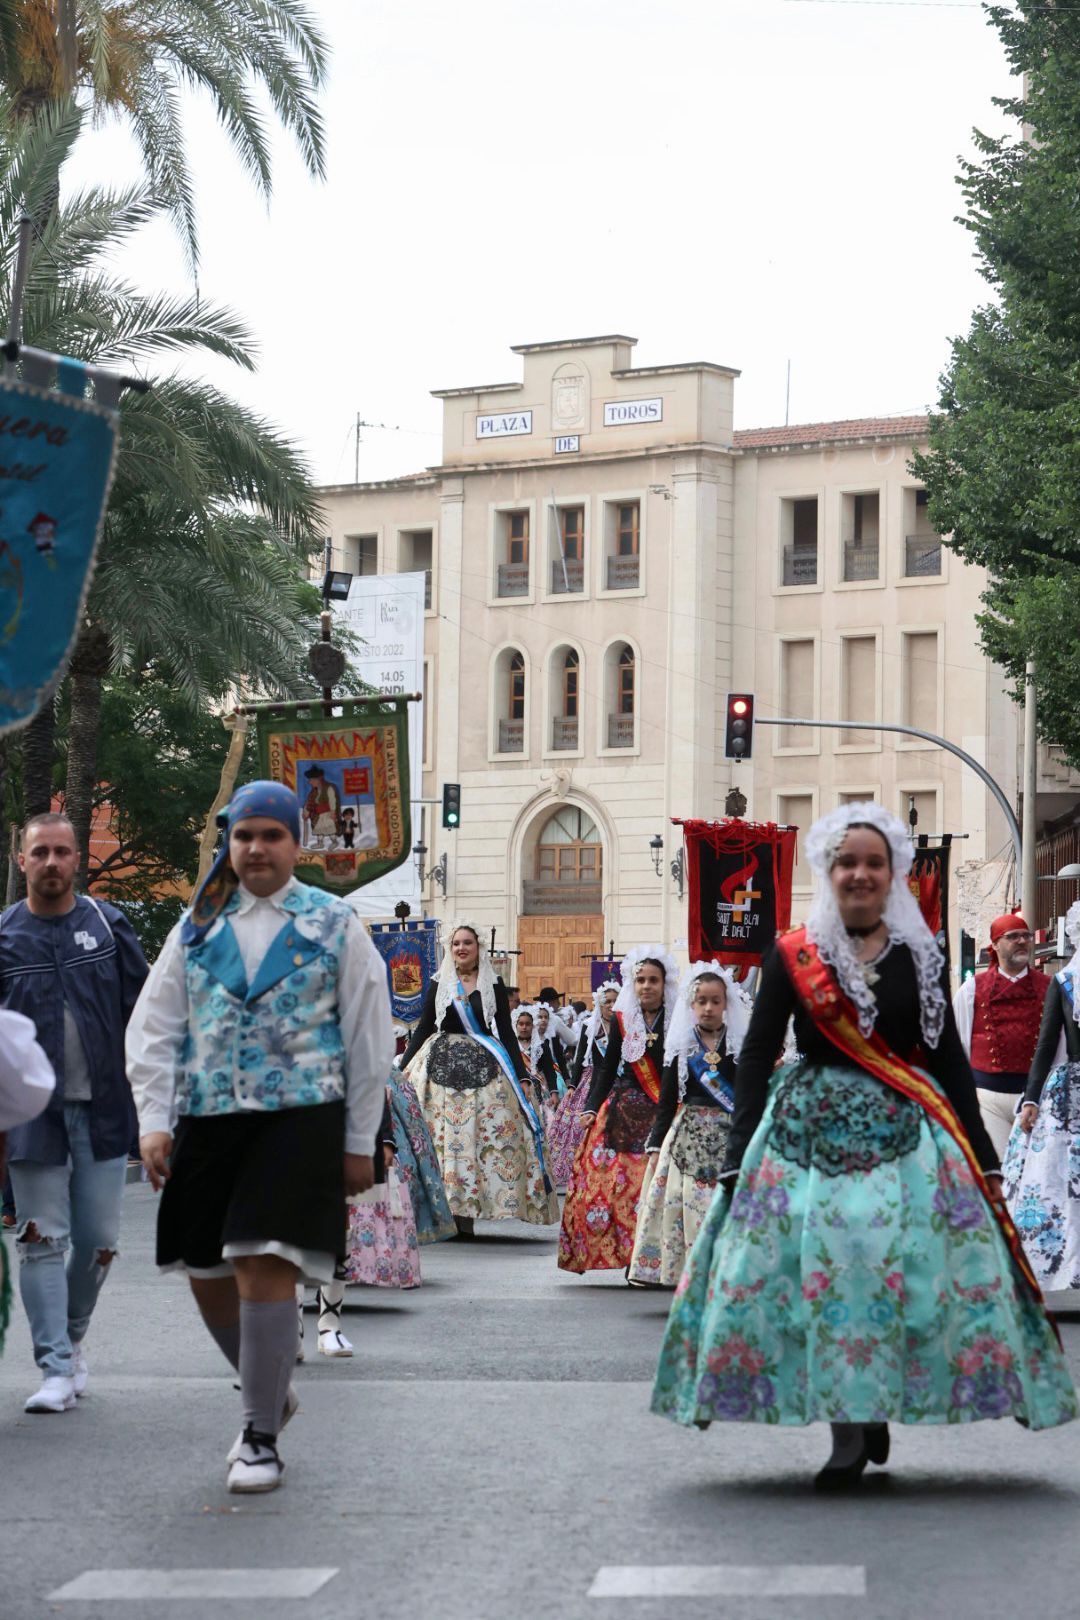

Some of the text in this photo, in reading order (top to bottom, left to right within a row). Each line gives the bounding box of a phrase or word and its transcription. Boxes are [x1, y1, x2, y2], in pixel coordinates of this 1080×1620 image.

[608, 403, 658, 421] TOROS
[480, 416, 528, 433] PLAZA
[558, 437, 576, 451] DE
[338, 608, 364, 620] ANTE
[384, 644, 405, 656] 2022
[380, 670, 405, 682] 14.05
[271, 742, 281, 782] FOGUE
[386, 752, 396, 783] SANT
[388, 784, 397, 798] DE
